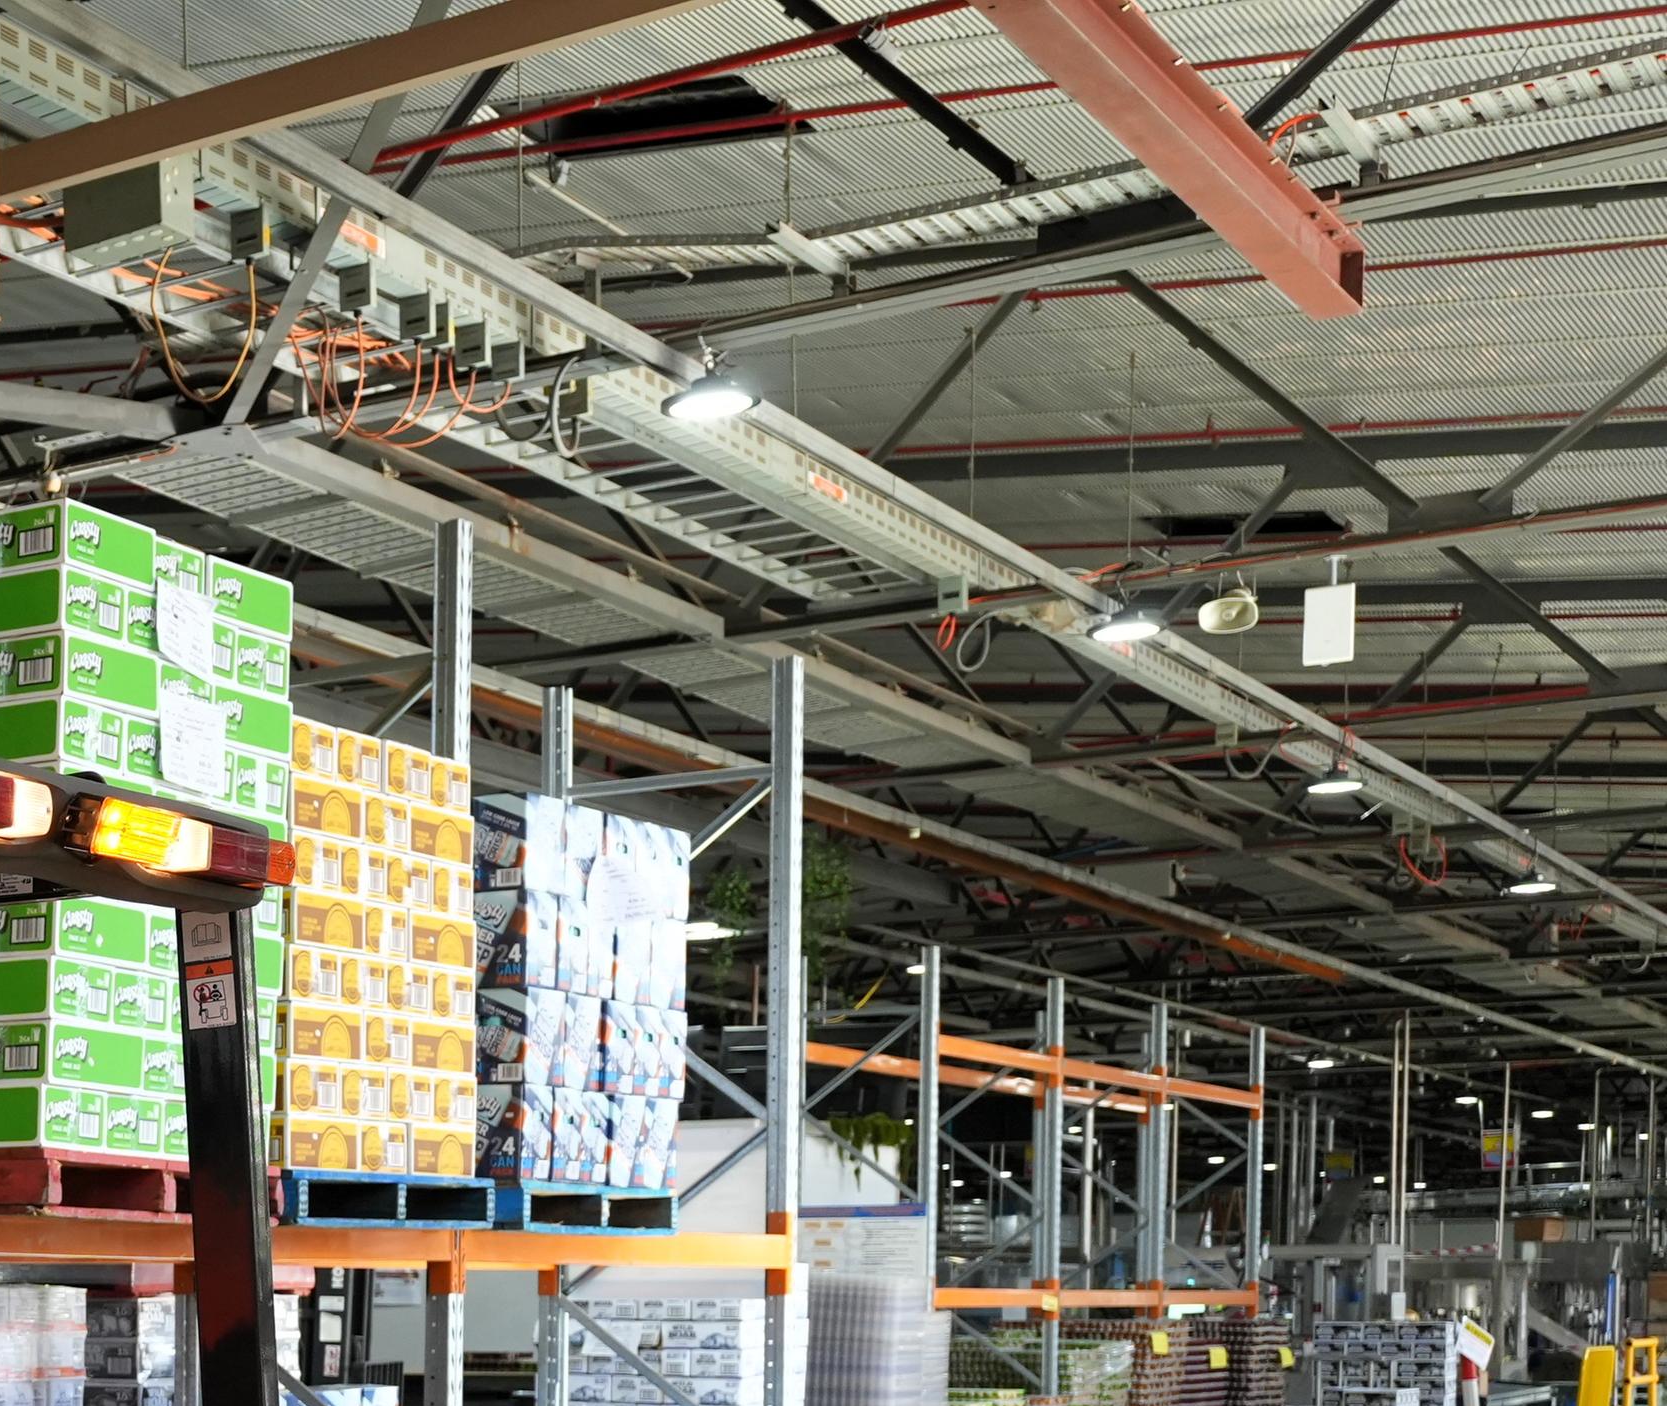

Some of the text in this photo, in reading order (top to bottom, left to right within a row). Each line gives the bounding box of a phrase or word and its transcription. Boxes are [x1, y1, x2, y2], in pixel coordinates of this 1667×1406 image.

[69, 519, 101, 549] Coasty
[496, 943, 522, 964] 24
[496, 964, 522, 975] CAN
[489, 1137, 516, 1156] 24
